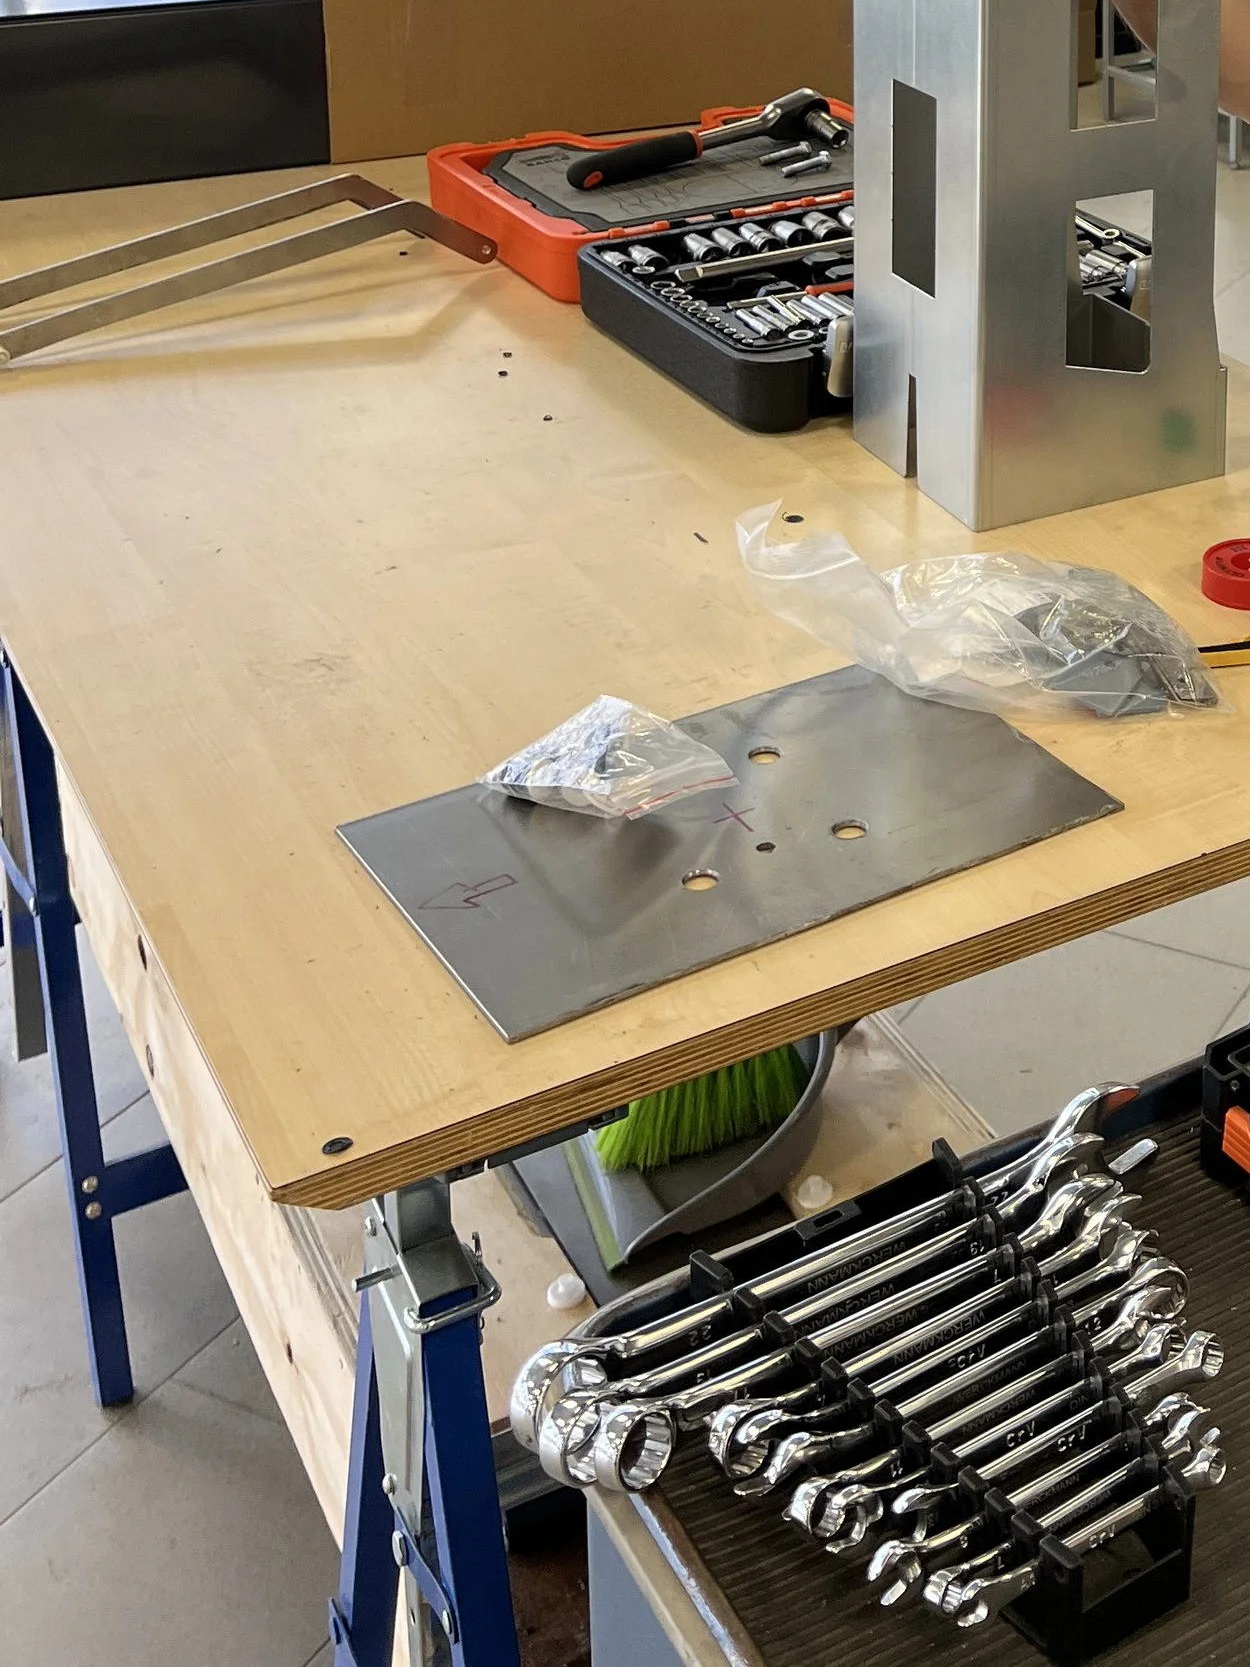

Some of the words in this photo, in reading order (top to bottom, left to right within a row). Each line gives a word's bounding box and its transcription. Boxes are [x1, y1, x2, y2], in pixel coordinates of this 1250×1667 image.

[805, 1241, 908, 1293] WERCKMANN
[686, 1322, 715, 1348] 22
[791, 1283, 896, 1337] WERCKMANN
[823, 1308, 919, 1358] WERCKMANN
[892, 1308, 986, 1364] WERCKMANN
[961, 1387, 1039, 1434] WERCKMANN
